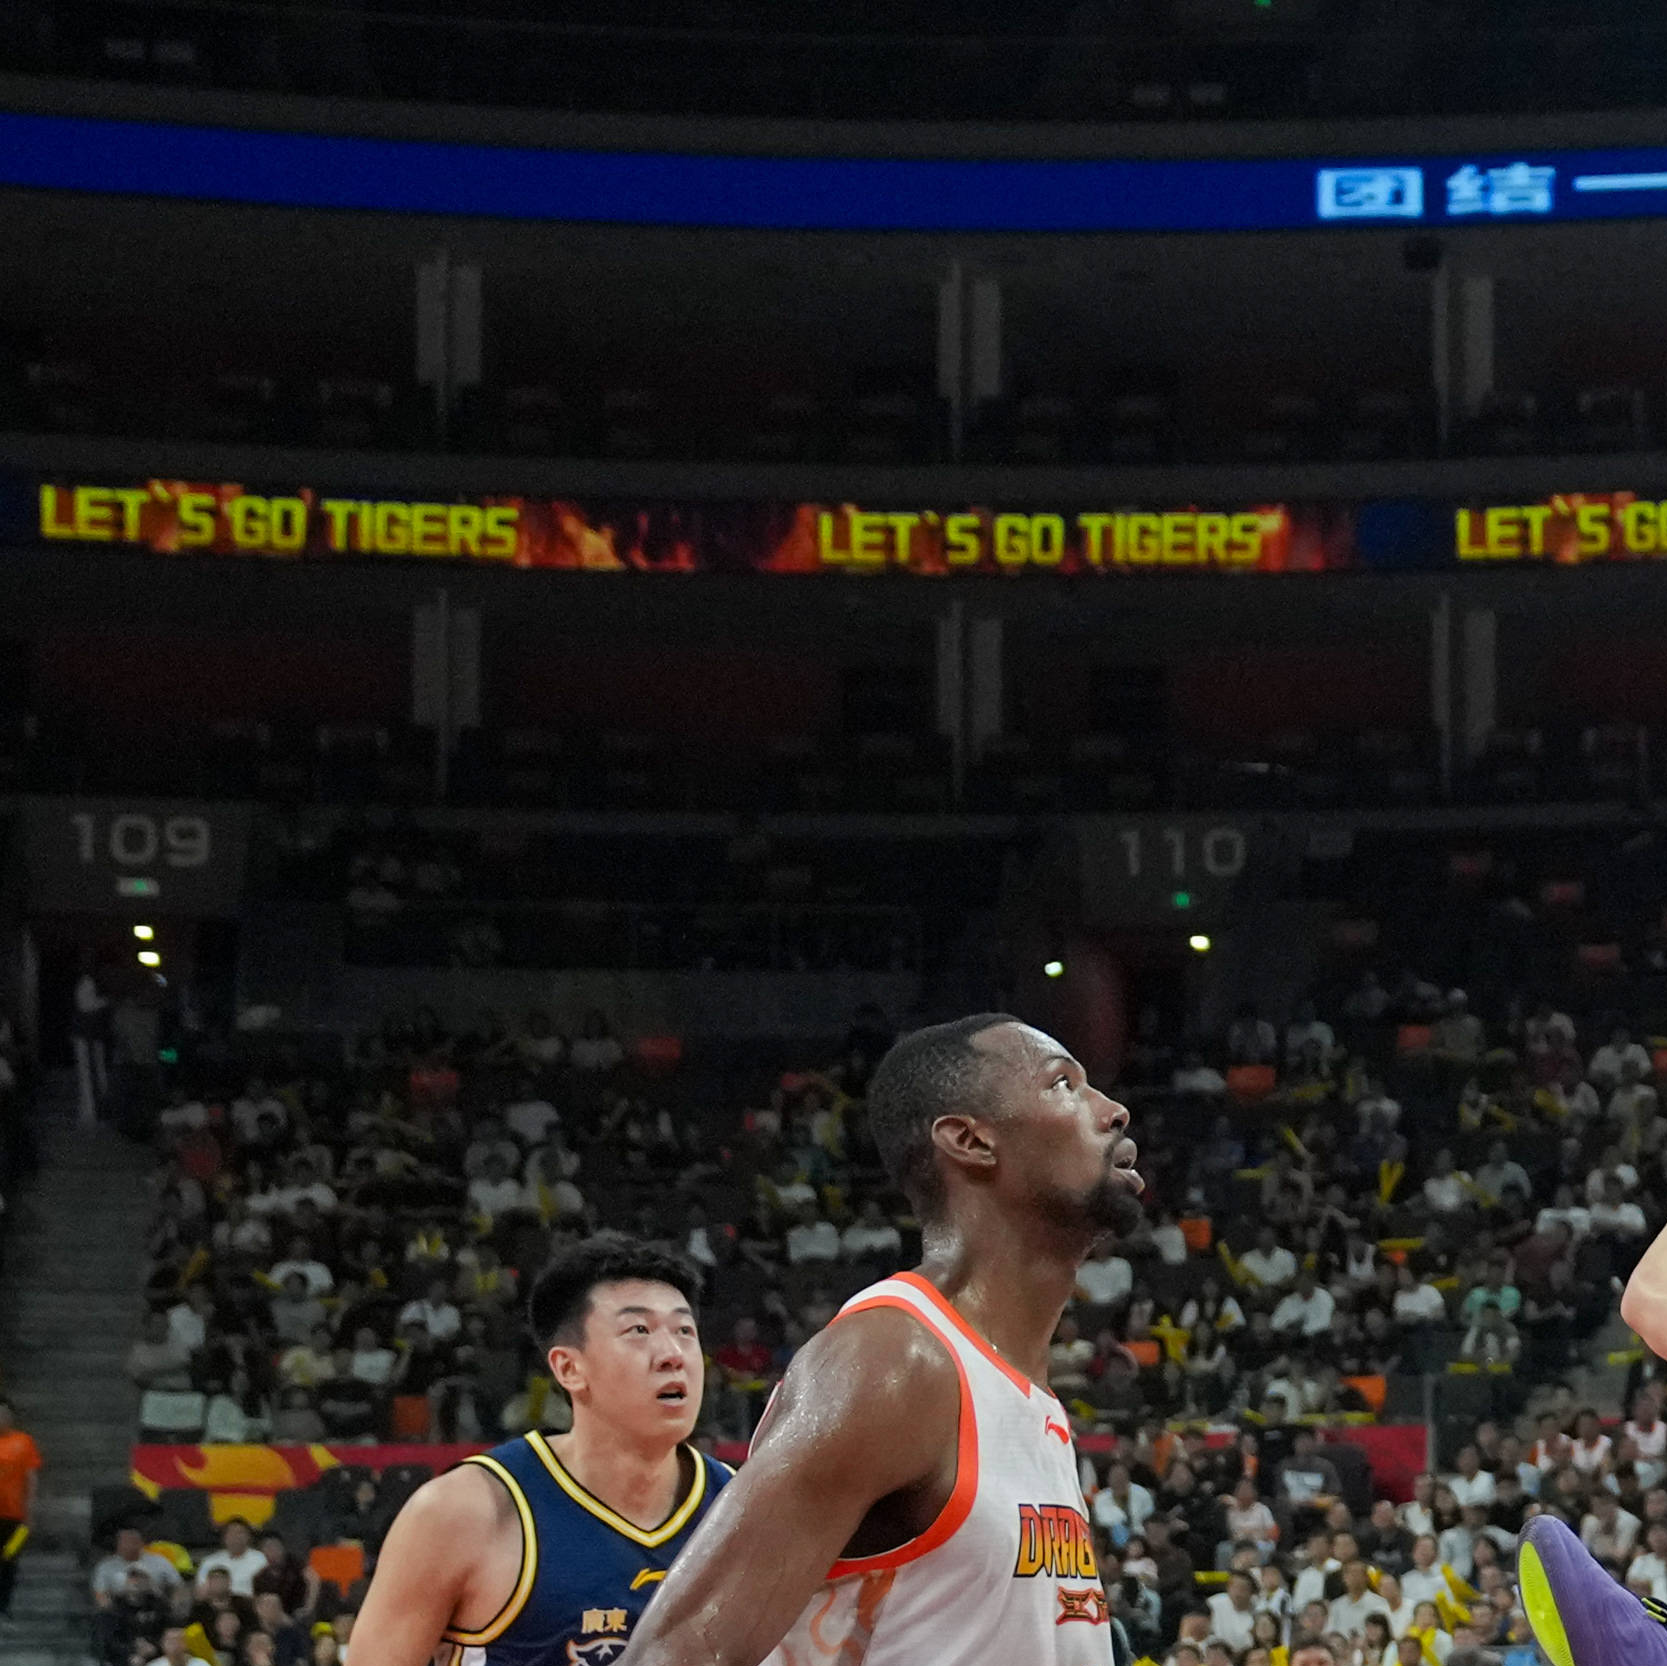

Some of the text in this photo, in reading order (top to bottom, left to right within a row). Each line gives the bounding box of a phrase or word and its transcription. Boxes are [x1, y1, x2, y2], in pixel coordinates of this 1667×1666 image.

[229, 495, 308, 550] GO
[322, 498, 520, 558] TIGERS
[993, 512, 1065, 565] GO
[1077, 511, 1263, 565] TIGERS
[69, 811, 212, 868] 109
[1119, 826, 1248, 877] 110
